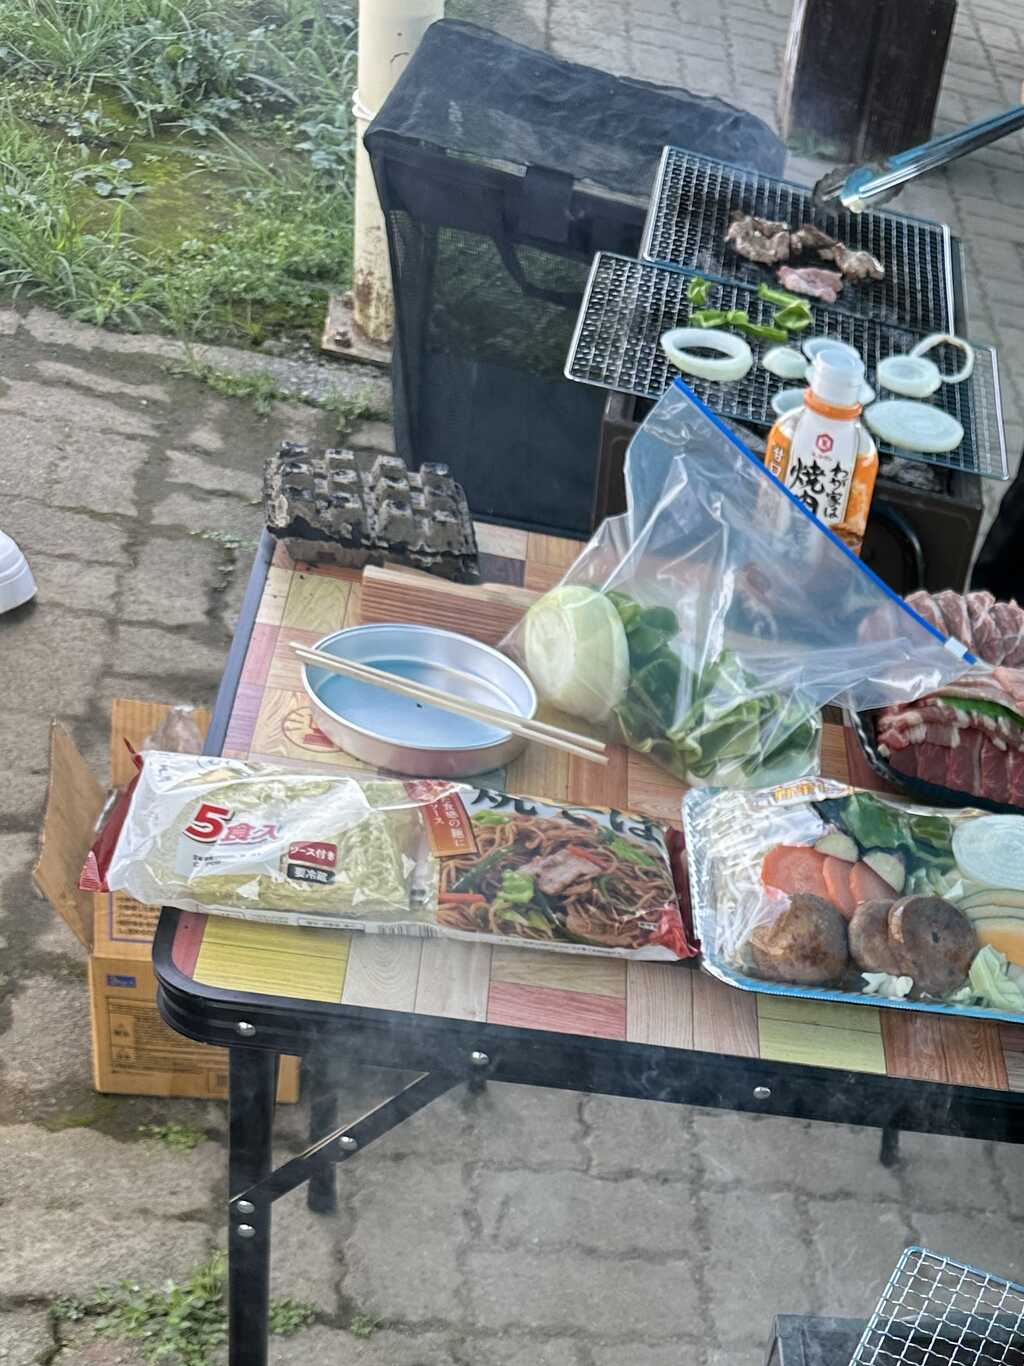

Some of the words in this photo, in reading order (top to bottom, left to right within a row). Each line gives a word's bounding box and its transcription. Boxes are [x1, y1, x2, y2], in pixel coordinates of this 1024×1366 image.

[825, 461, 850, 519] わが家は
[290, 846, 335, 862] ソース付き
